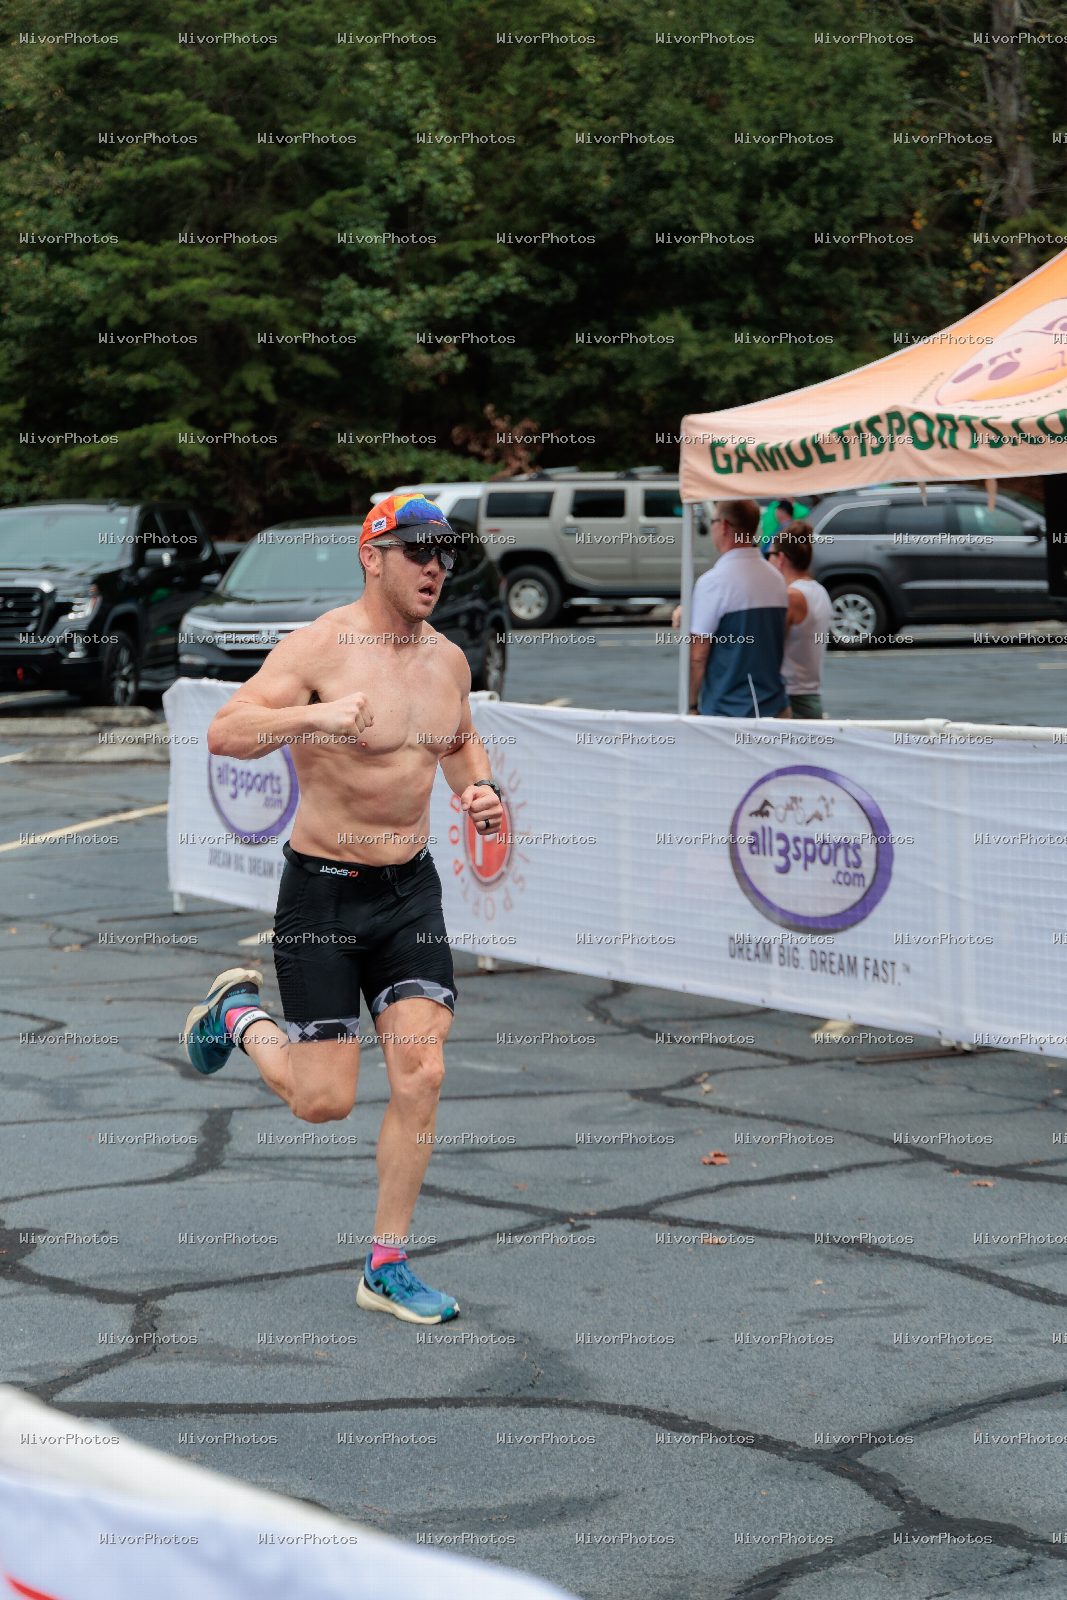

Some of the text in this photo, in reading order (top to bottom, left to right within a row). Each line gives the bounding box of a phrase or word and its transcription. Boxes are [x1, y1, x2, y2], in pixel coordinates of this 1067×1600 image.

[749, 825, 862, 874] all3sports
[832, 869, 866, 888] .com
[809, 949, 859, 979] DREAM
